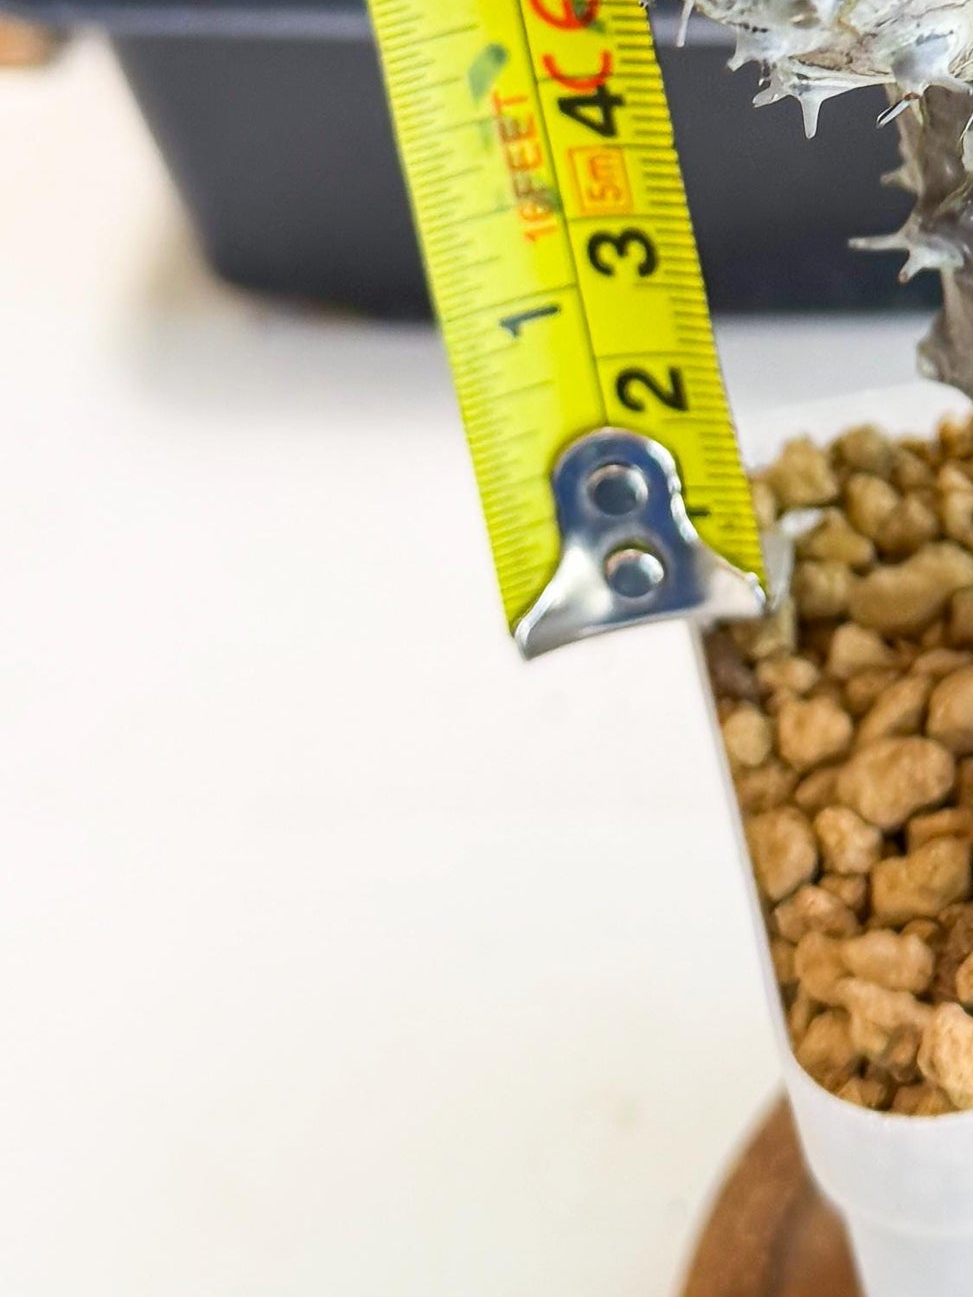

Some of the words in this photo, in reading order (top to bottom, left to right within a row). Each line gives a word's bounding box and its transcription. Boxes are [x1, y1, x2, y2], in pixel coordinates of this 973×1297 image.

[557, 84, 625, 138] 4
[586, 226, 660, 279] 3
[499, 304, 561, 339] 1
[614, 365, 690, 414] 2
